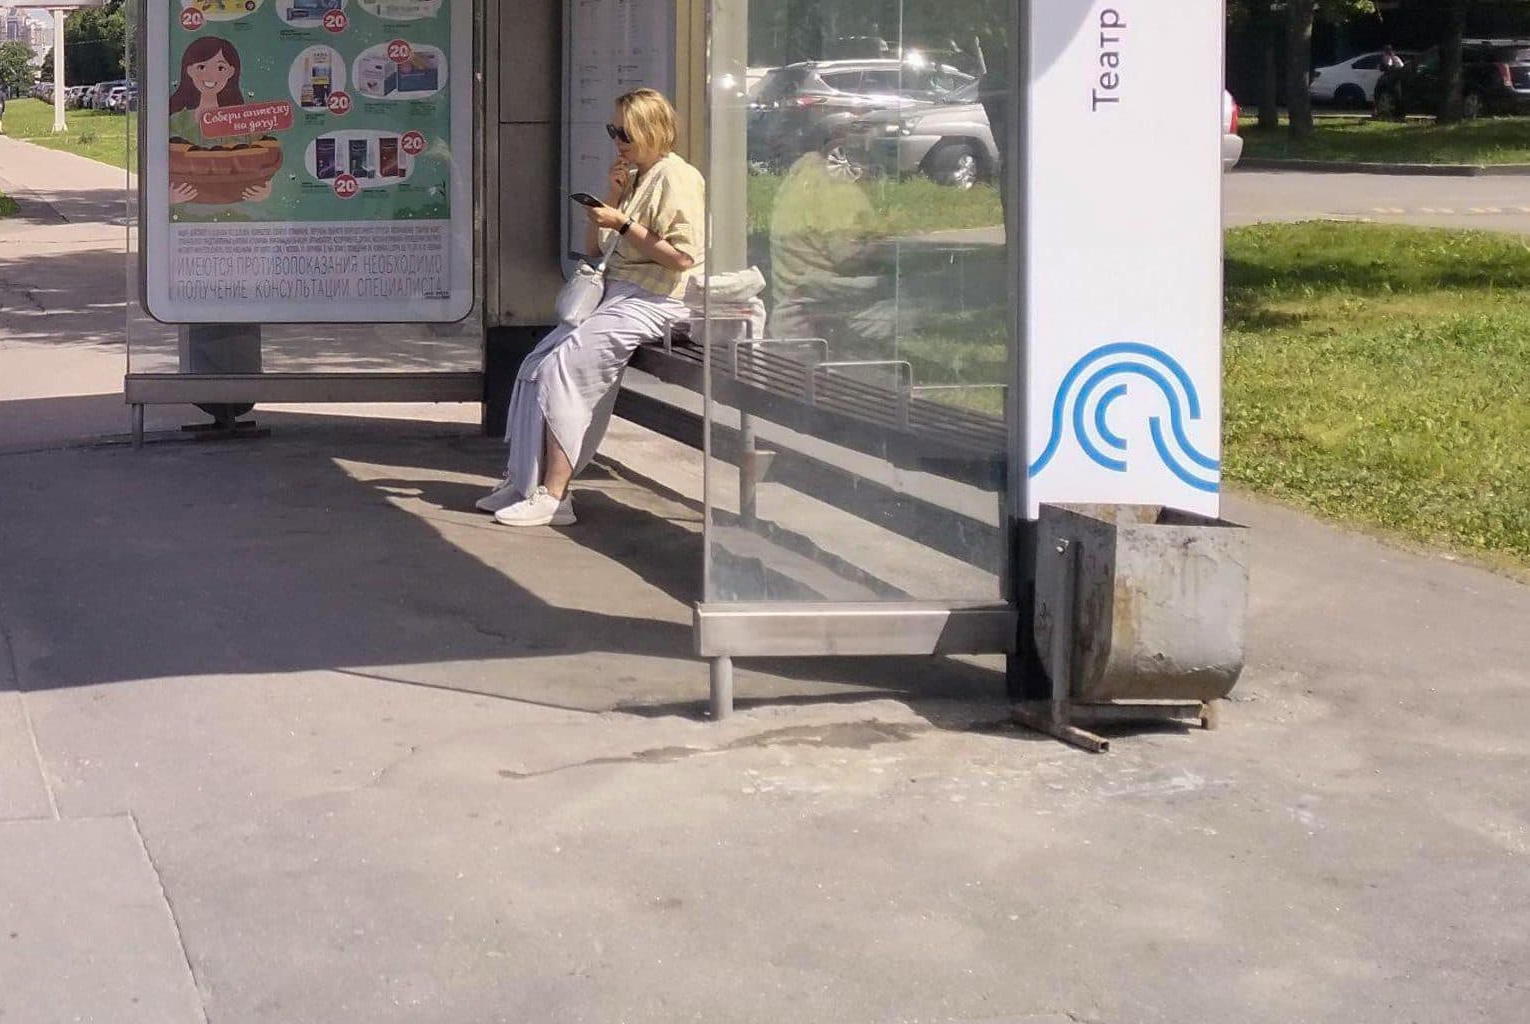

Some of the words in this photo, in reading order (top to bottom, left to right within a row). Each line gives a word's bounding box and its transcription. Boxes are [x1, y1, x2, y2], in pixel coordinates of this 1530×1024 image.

[181, 12, 202, 25] 20
[325, 15, 345, 28] 20
[389, 45, 410, 58] 20
[1092, 8, 1126, 112] Театр
[329, 96, 348, 110] 20
[203, 111, 242, 127] Собери
[403, 137, 423, 150] 20
[336, 179, 357, 193] 20
[177, 256, 233, 276] ИМЕЮТСЯ
[179, 280, 248, 299] ПОЛУЧЕНИЕ
[255, 278, 350, 299] КОНСУЛЬТАЦИИ
